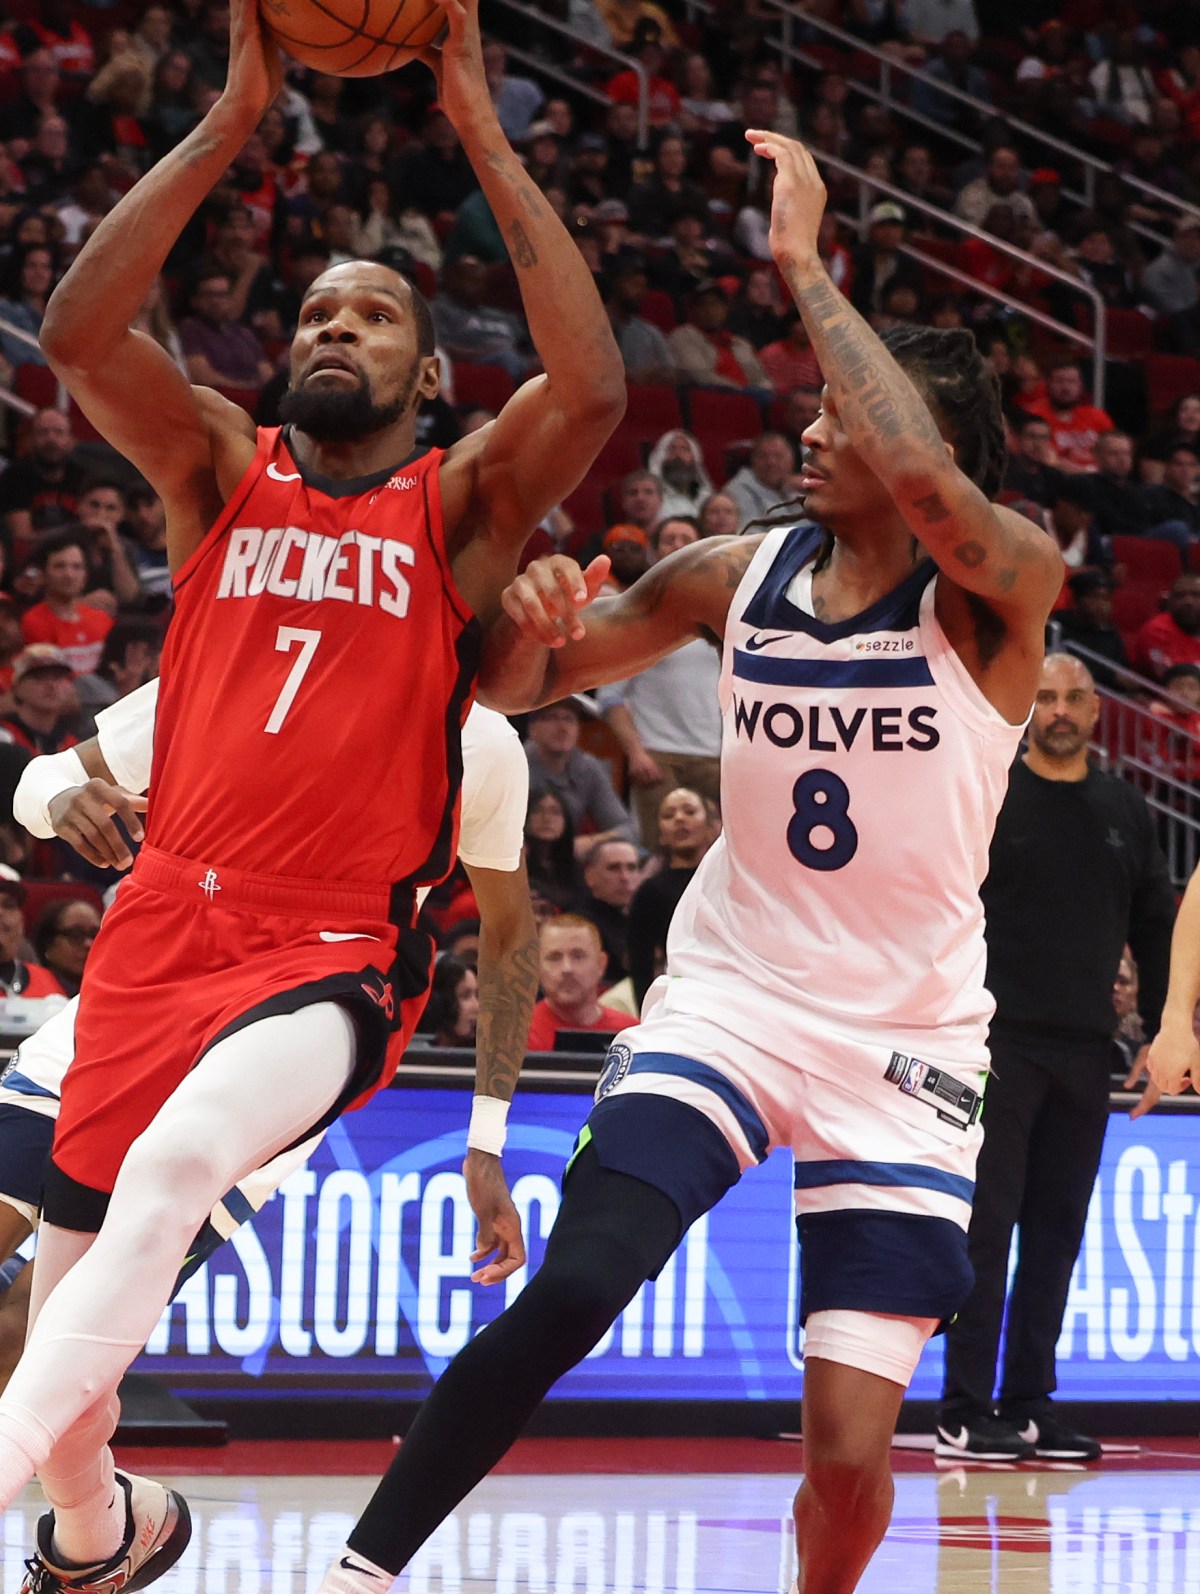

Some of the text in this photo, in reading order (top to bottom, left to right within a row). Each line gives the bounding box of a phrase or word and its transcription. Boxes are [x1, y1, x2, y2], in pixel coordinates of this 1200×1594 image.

[216, 526, 415, 619] ROCKETS
[263, 625, 322, 734] 7
[865, 638, 914, 652] sezzle
[732, 691, 940, 752] WOLVES
[786, 768, 858, 872] 8
